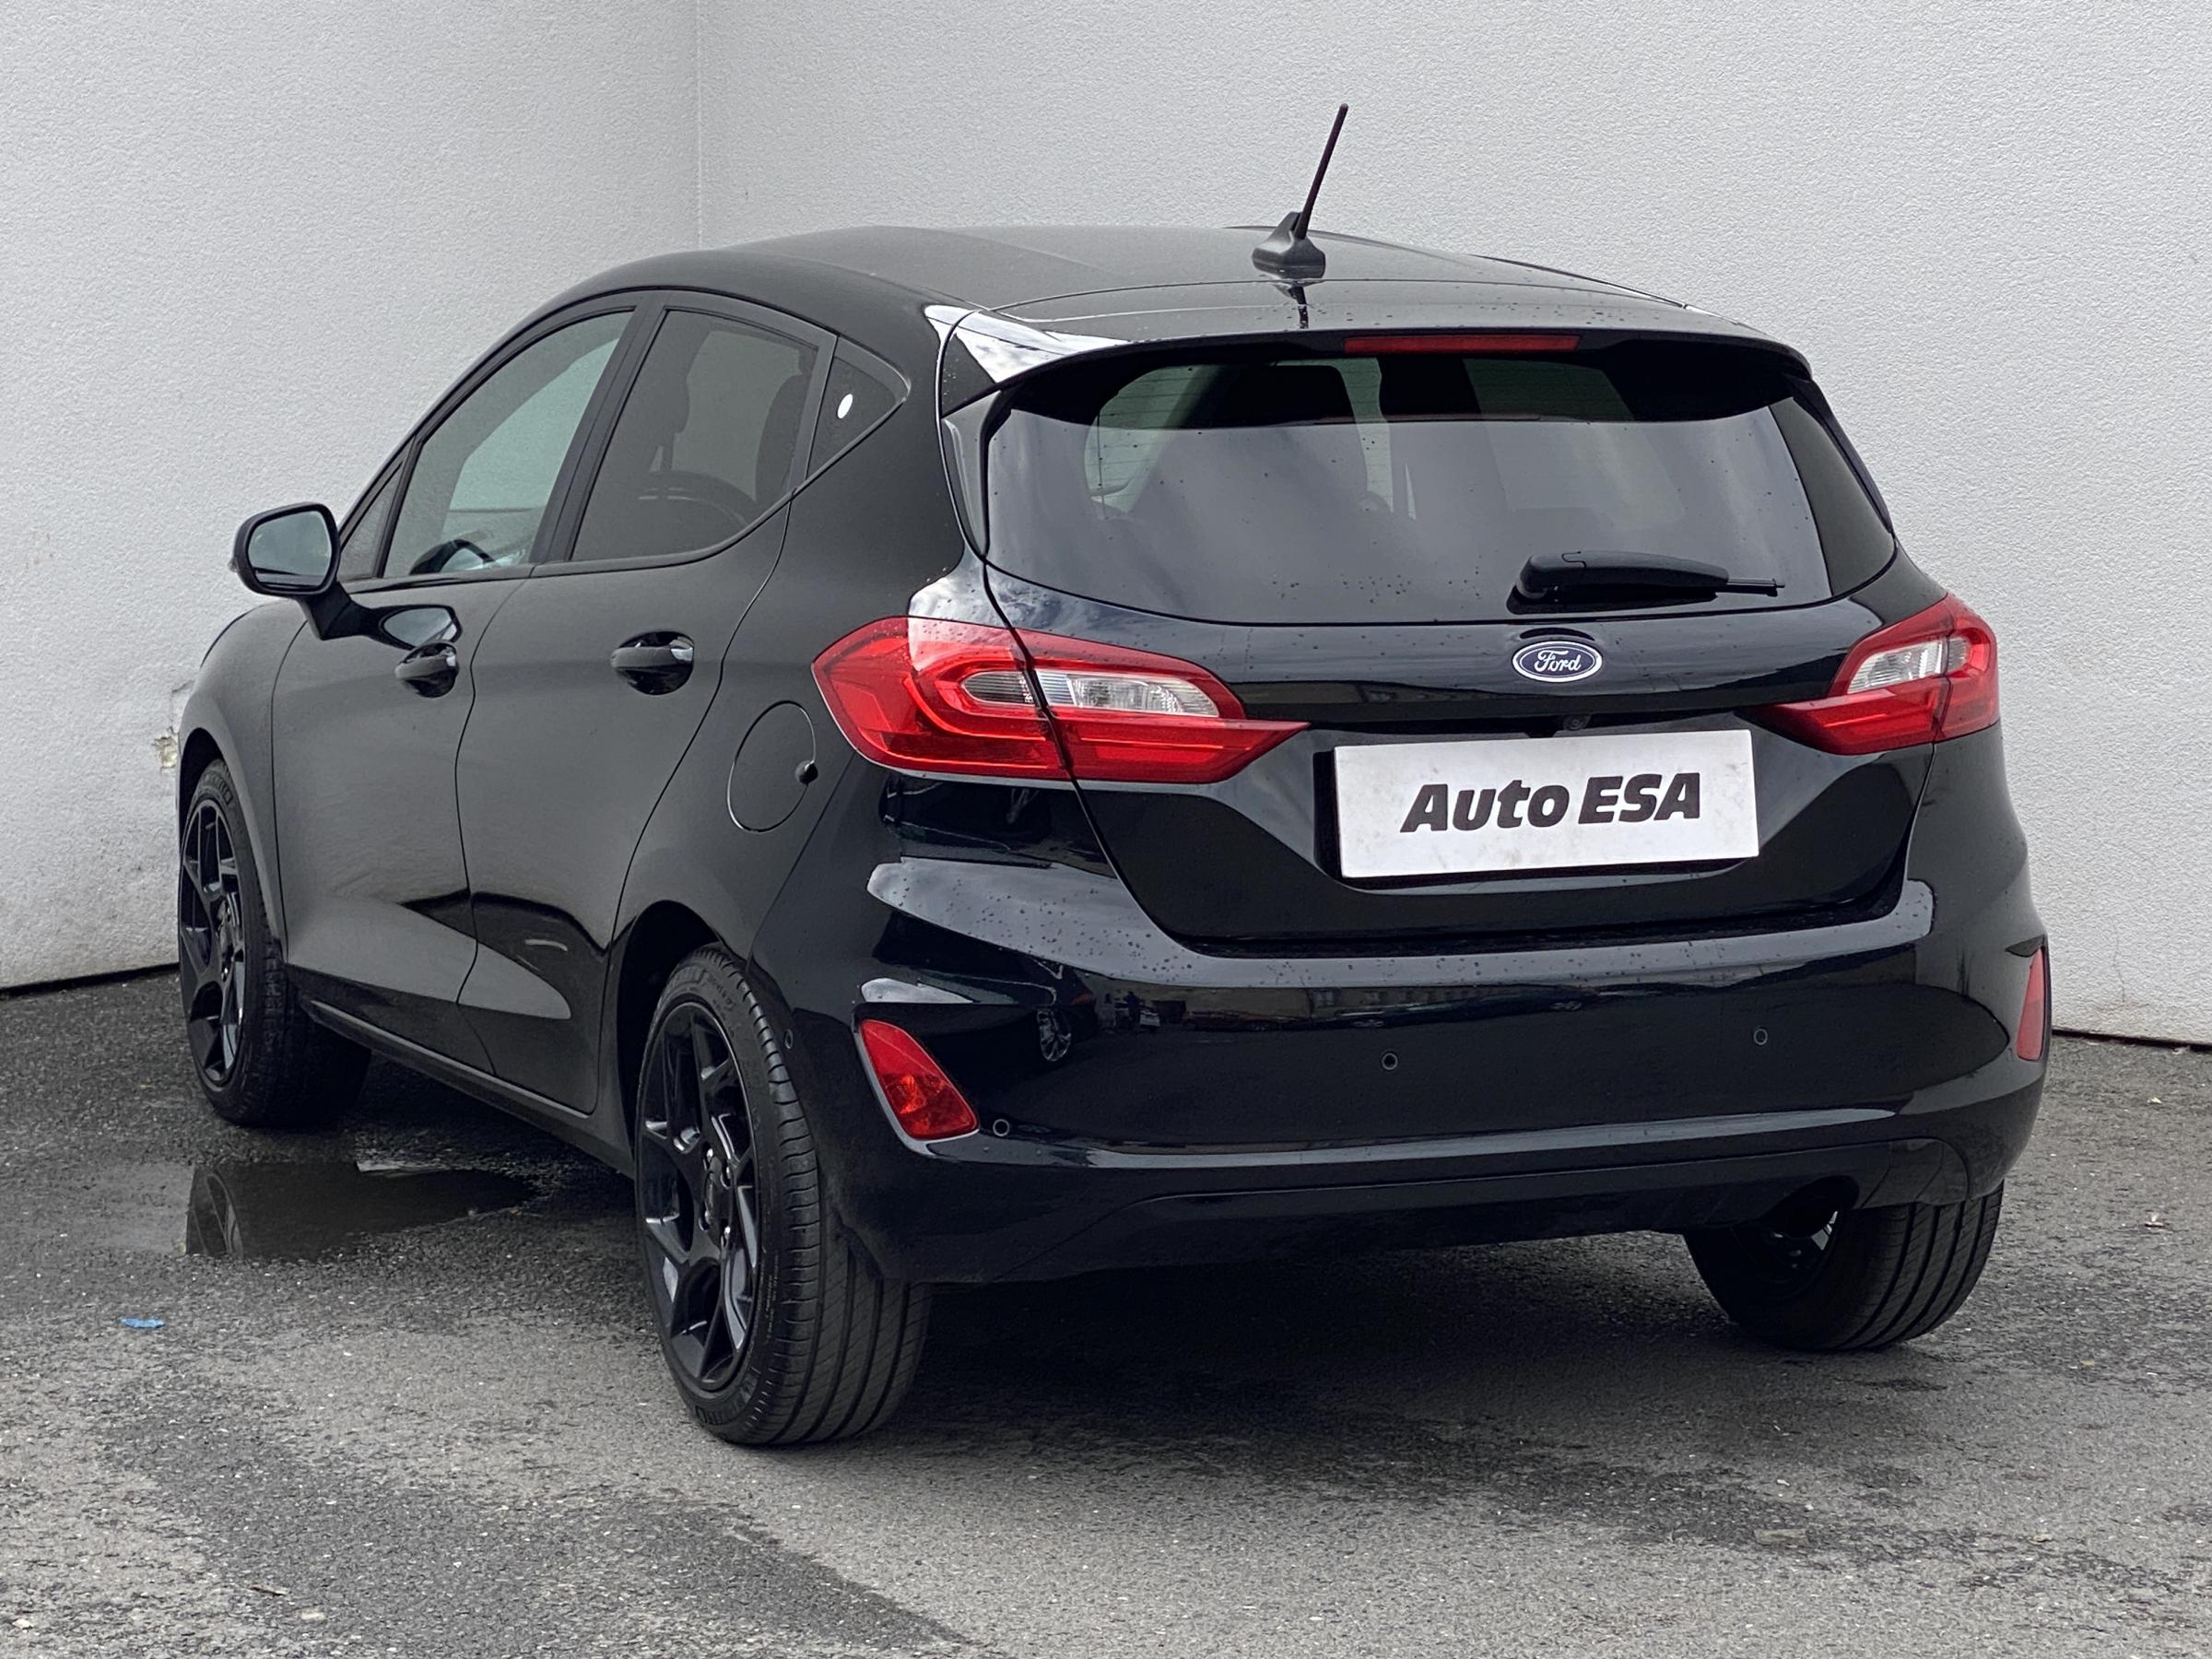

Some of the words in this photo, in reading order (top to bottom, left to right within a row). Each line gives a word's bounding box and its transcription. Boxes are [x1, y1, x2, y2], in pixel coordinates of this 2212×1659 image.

[1534, 650, 1582, 672] Ford
[1399, 780, 1570, 833] Auto
[1578, 772, 1700, 825] ESA
